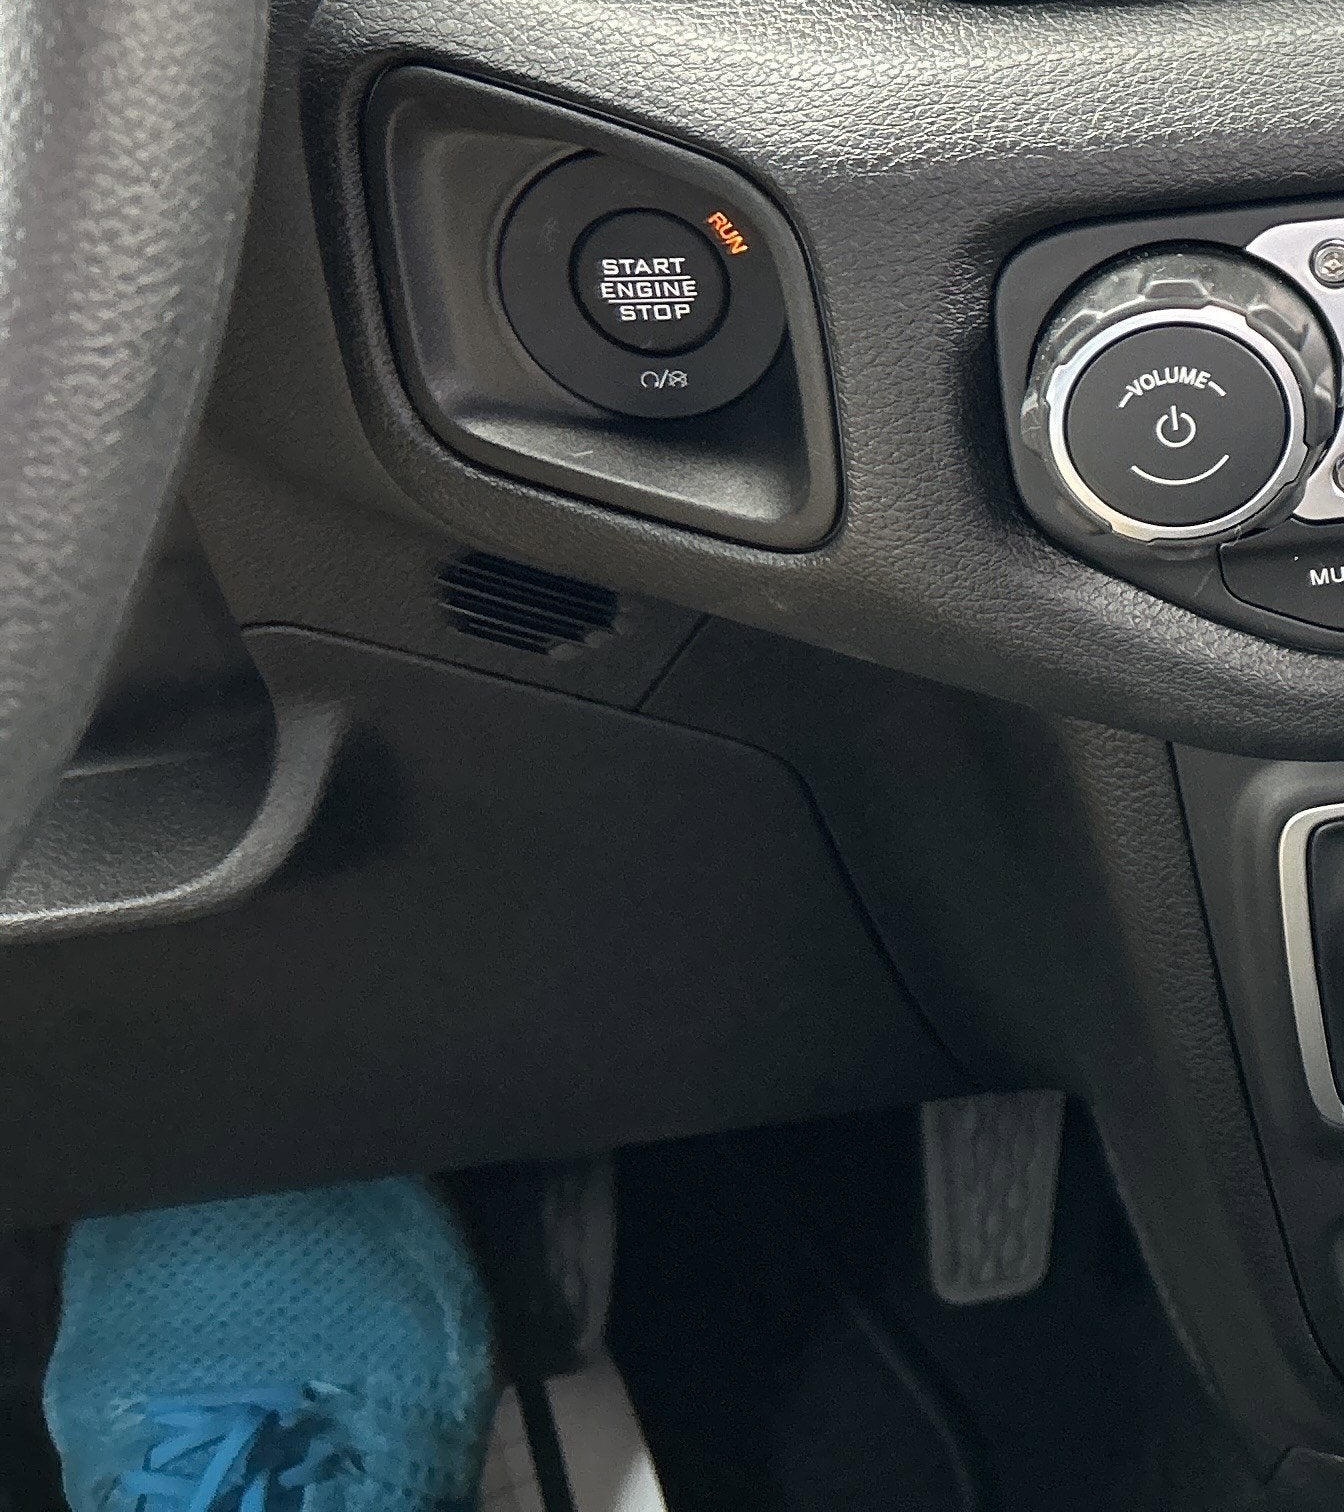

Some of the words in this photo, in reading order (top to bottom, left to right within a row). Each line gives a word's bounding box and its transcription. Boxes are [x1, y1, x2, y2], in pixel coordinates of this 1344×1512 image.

[706, 211, 749, 255] RUN
[601, 257, 686, 276] START
[600, 279, 698, 299] ENGINE
[619, 303, 692, 322] STOP
[1127, 366, 1212, 399] VOLUME
